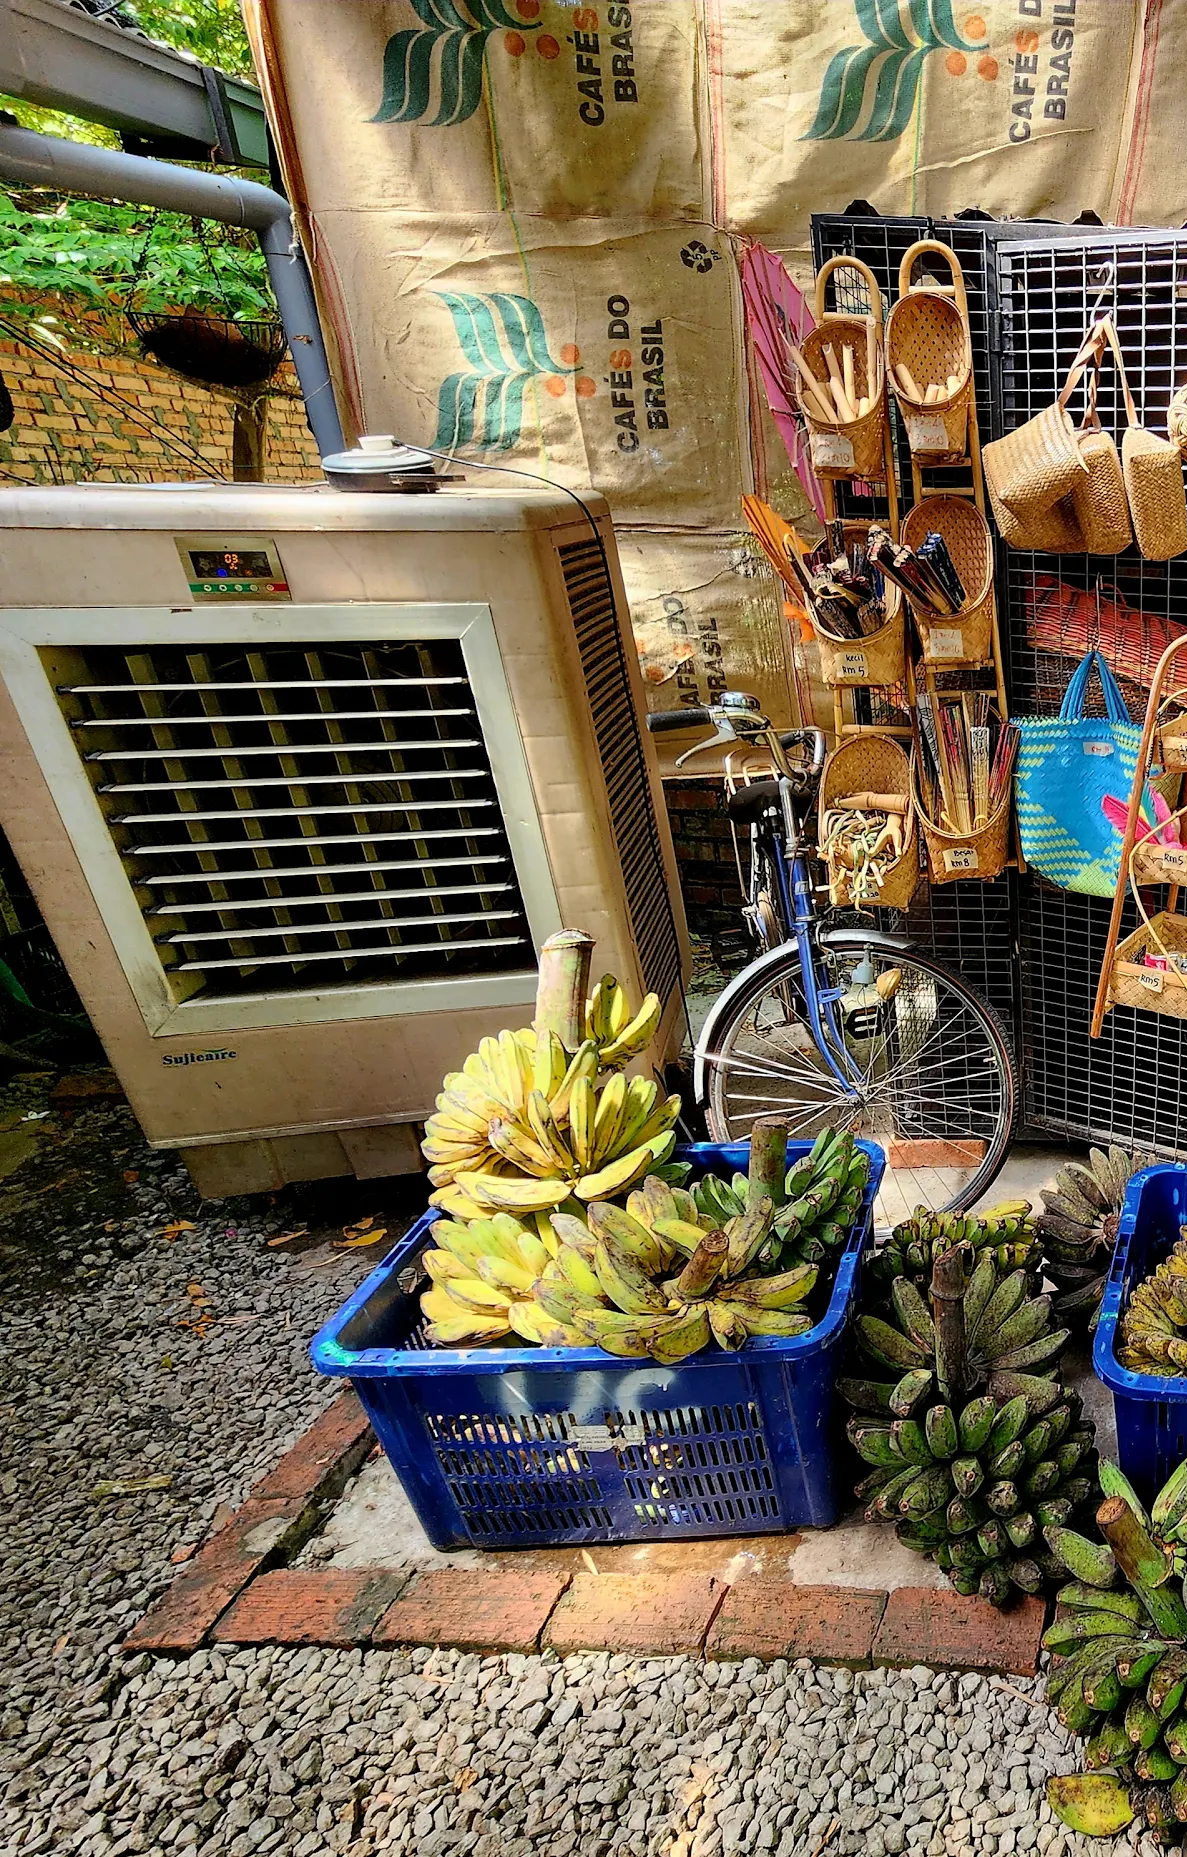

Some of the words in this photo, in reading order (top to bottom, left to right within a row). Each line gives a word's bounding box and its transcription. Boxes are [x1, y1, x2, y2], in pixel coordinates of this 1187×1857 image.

[607, 0, 638, 103] BRAS
[1008, 30, 1040, 143] CAFÉS
[607, 294, 630, 340] DO
[603, 349, 640, 453] CAFÉS
[641, 319, 670, 430] BRASIL
[224, 553, 239, 564] 03
[663, 597, 688, 635] DO
[858, 665, 865, 677] 5
